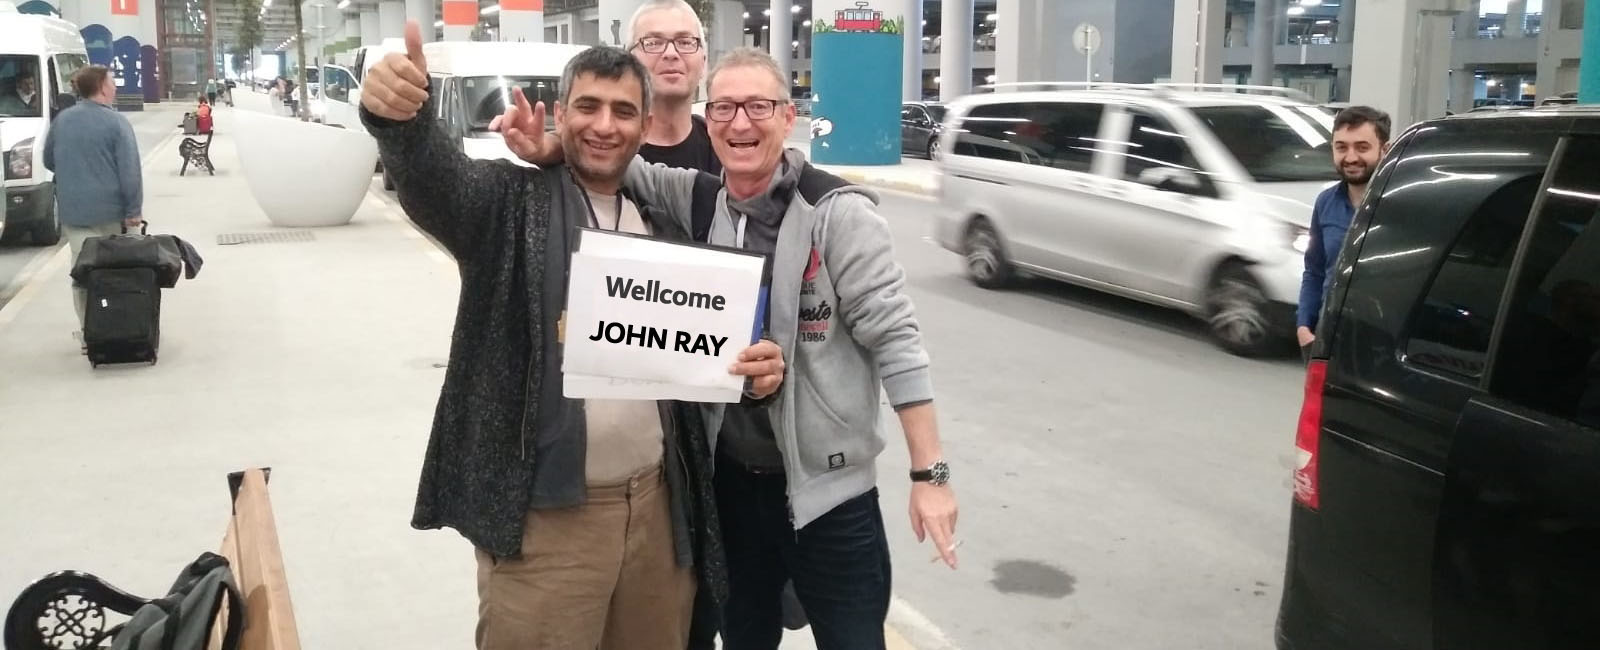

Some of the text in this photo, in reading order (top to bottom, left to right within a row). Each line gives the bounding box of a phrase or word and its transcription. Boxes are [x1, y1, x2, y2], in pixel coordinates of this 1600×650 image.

[606, 275, 726, 312] Wellcome
[589, 320, 729, 357] JOHN RAY
[801, 331, 826, 342] 1986
